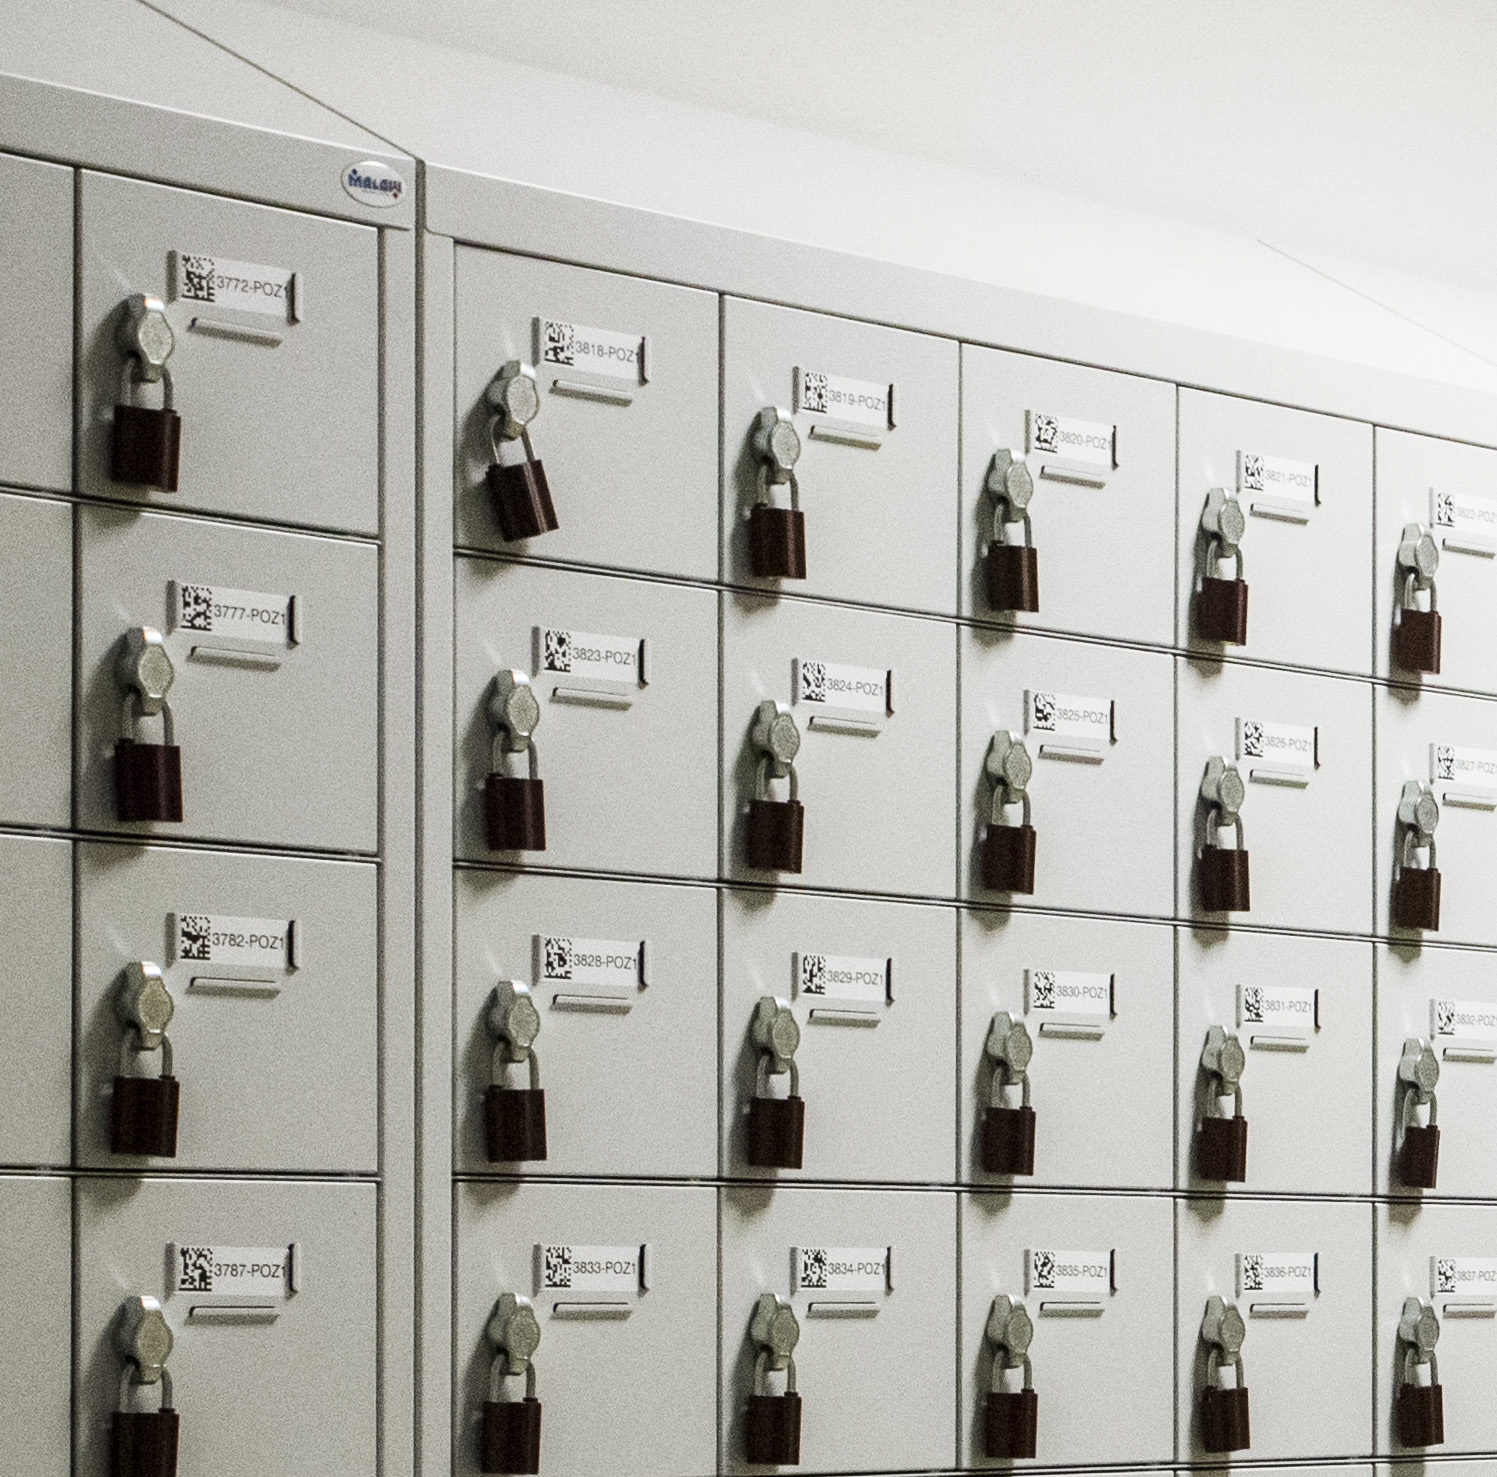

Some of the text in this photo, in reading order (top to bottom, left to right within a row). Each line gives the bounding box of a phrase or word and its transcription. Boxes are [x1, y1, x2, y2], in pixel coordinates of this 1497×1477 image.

[829, 390, 886, 411] 3819-POZ1
[1060, 432, 1112, 449] 3820-POZ1
[1265, 471, 1312, 487] 3821-POZ1
[214, 604, 286, 626] 3777-POZ1
[572, 646, 636, 666] 3823-POZ1
[827, 678, 883, 696] 3824-POZ1
[1057, 709, 1108, 725] 3825-POZ1
[1265, 736, 1312, 751] 3826-POZ1
[212, 931, 284, 950] 3782-POZ1
[573, 954, 637, 970] 3828-POZ1
[827, 970, 883, 985] 3829-POZ1
[1056, 987, 1108, 1000] 3830-POZ1
[1265, 1000, 1312, 1012] 3831-POZ1
[214, 1264, 285, 1279] 3787-POZ1
[573, 1262, 636, 1275] 3833-POZ1
[828, 1263, 885, 1276] 3834-POZ1
[1057, 1264, 1108, 1277] 3835-POZ1
[1265, 1267, 1311, 1278] 3836-POZ1
